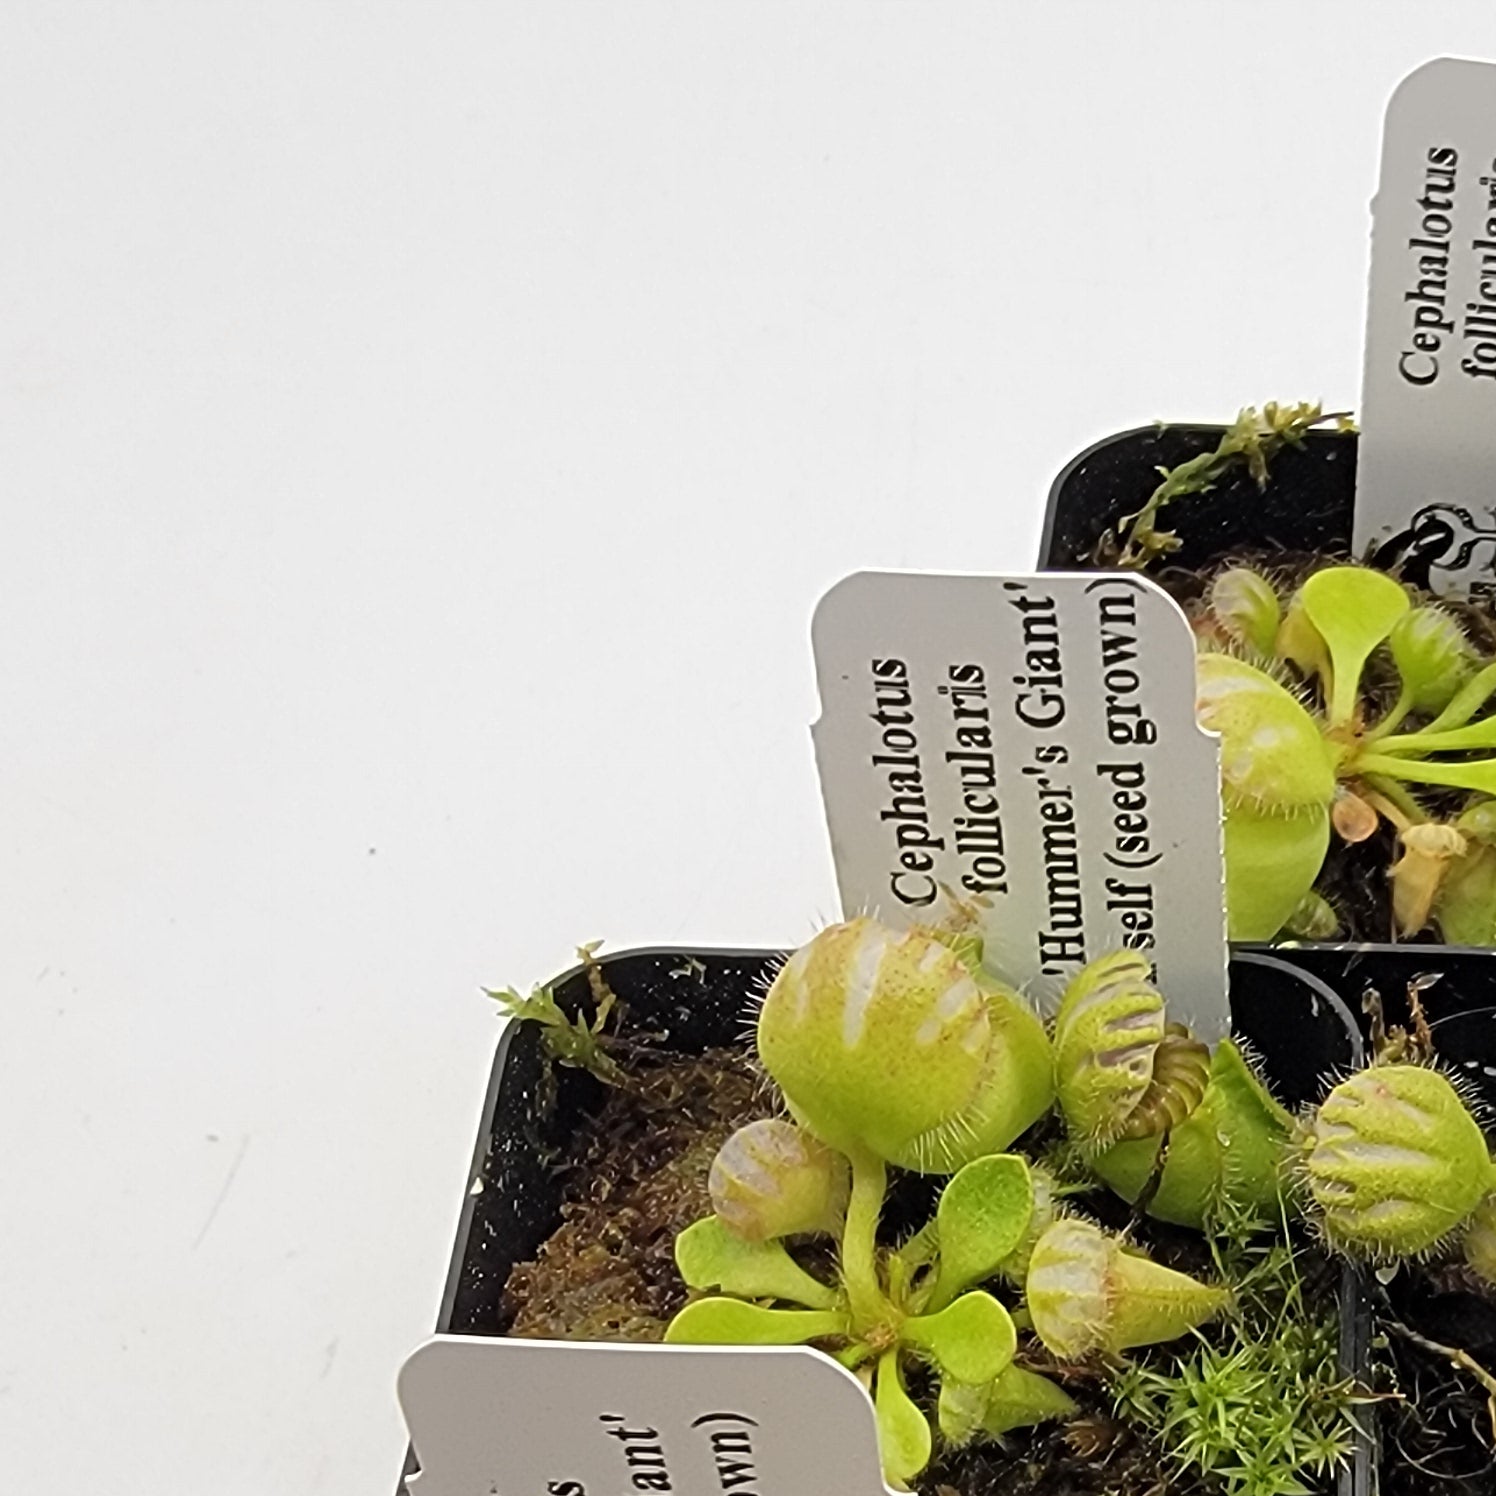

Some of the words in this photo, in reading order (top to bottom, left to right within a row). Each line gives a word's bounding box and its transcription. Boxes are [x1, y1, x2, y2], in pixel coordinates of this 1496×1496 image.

[1399, 147, 1458, 386] Cephalotus
[1003, 581, 1067, 728] Giant'
[1084, 577, 1157, 745] grown)
[871, 658, 945, 906] Cephalotus
[937, 664, 1008, 895] follicularis
[1022, 745, 1087, 976] 'Hummer's
[1097, 762, 1164, 868] (seed
